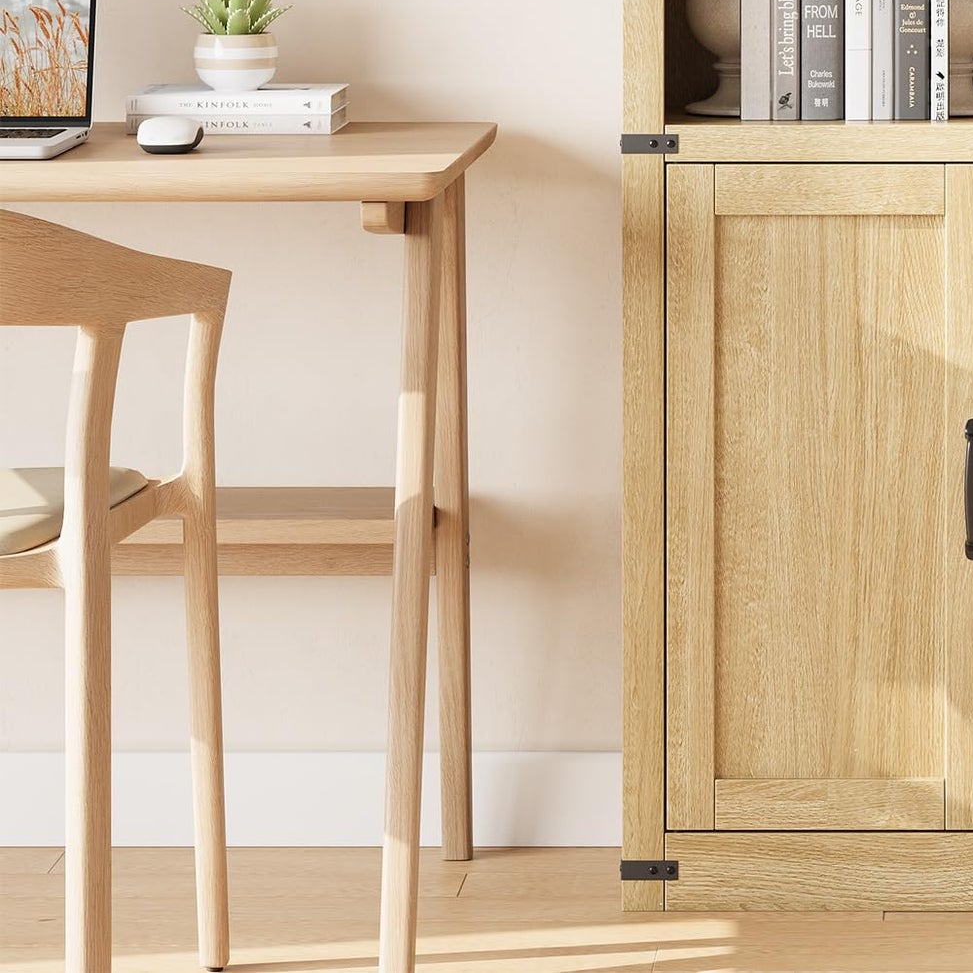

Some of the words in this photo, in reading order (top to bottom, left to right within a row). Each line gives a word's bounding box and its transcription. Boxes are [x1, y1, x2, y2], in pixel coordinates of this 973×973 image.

[804, 5, 838, 18] FROM
[779, 11, 798, 45] bring
[807, 25, 836, 38] HELL
[779, 47, 794, 76] Let's
[810, 70, 833, 78] Charles
